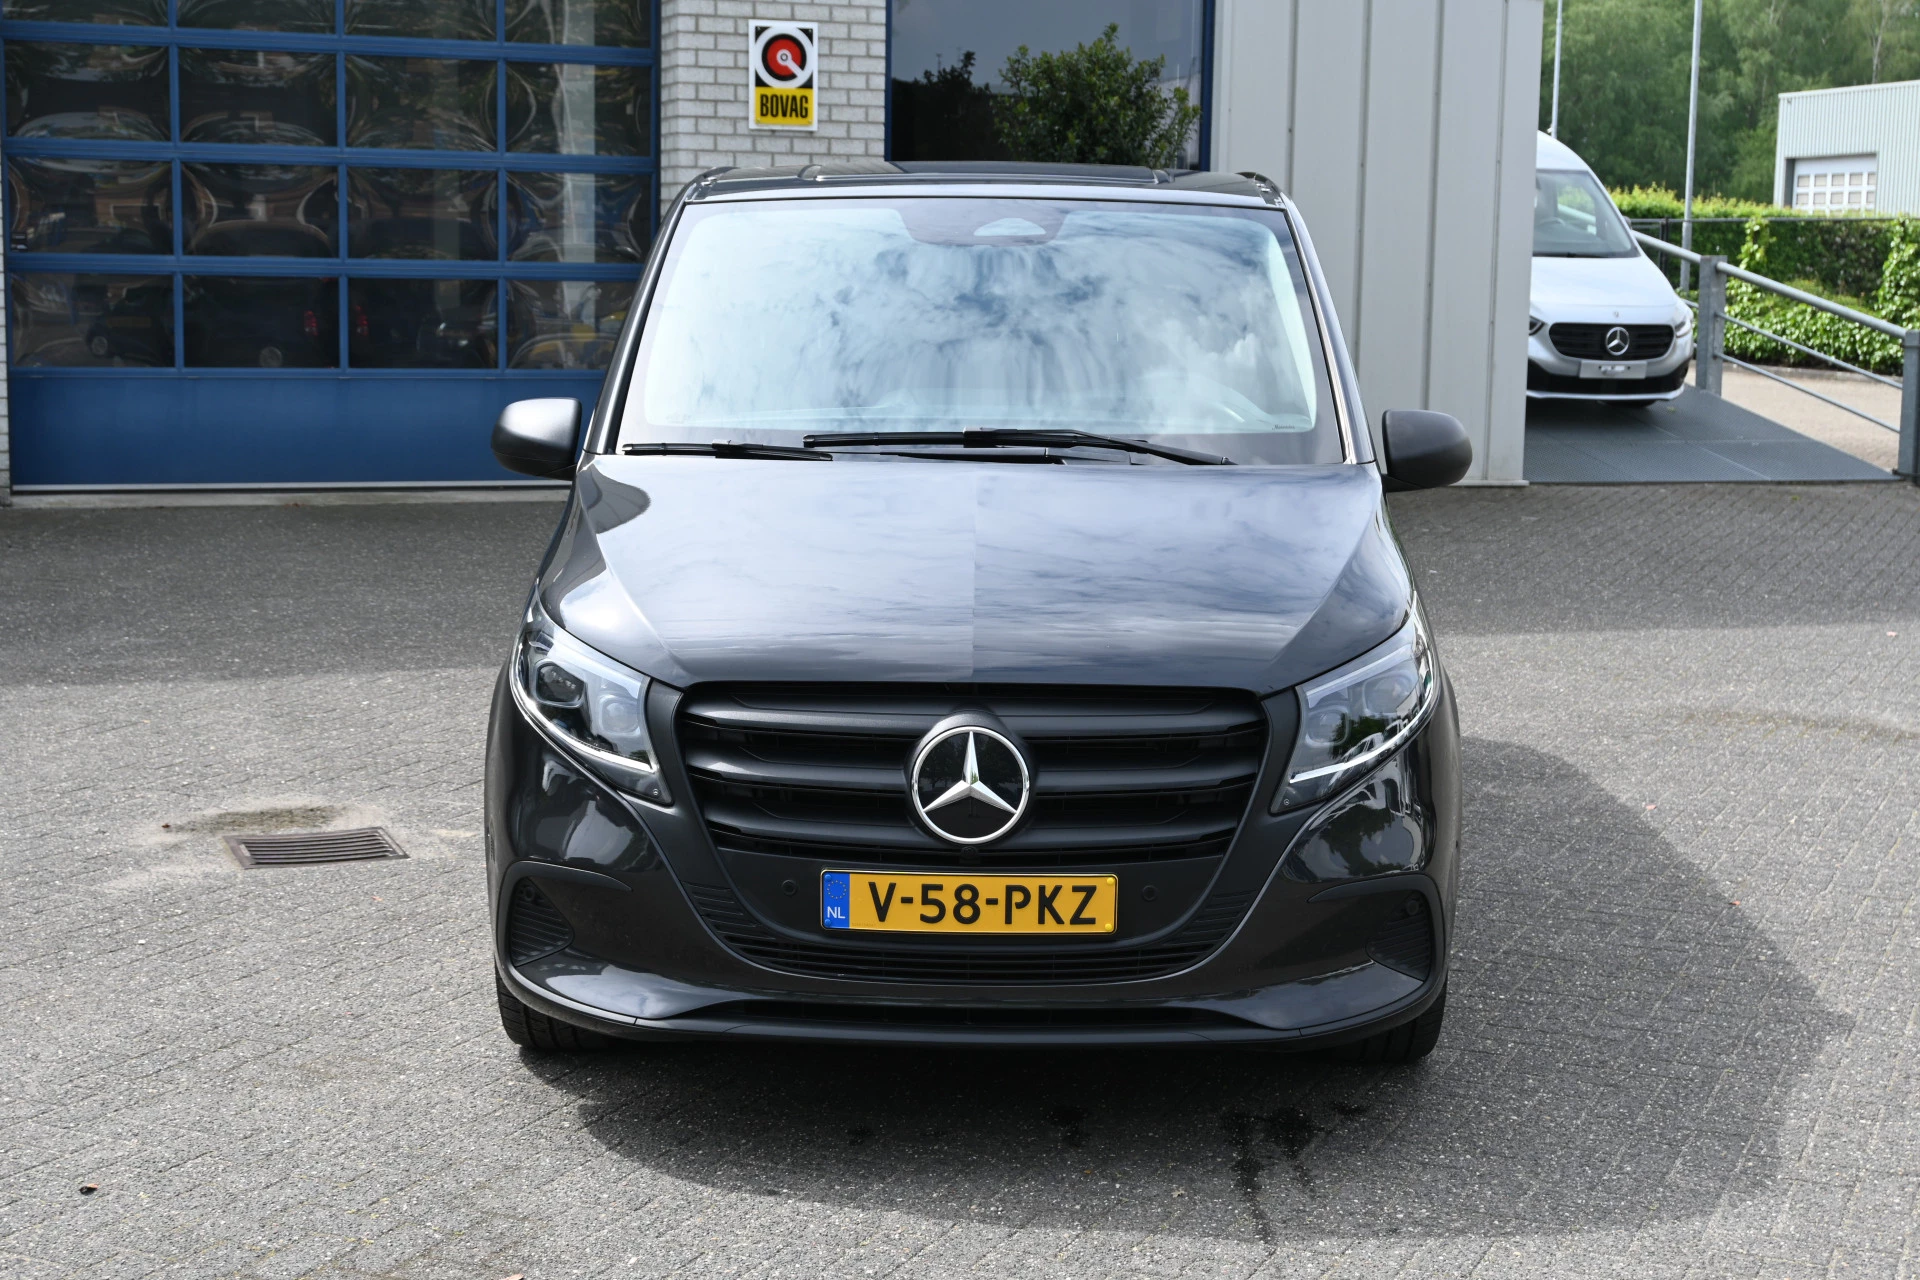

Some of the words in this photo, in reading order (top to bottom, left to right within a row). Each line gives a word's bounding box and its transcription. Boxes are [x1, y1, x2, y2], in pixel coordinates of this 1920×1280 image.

[760, 94, 808, 118] BOVAG
[827, 906, 846, 919] NL
[868, 881, 1097, 925] V-58-PKZ
